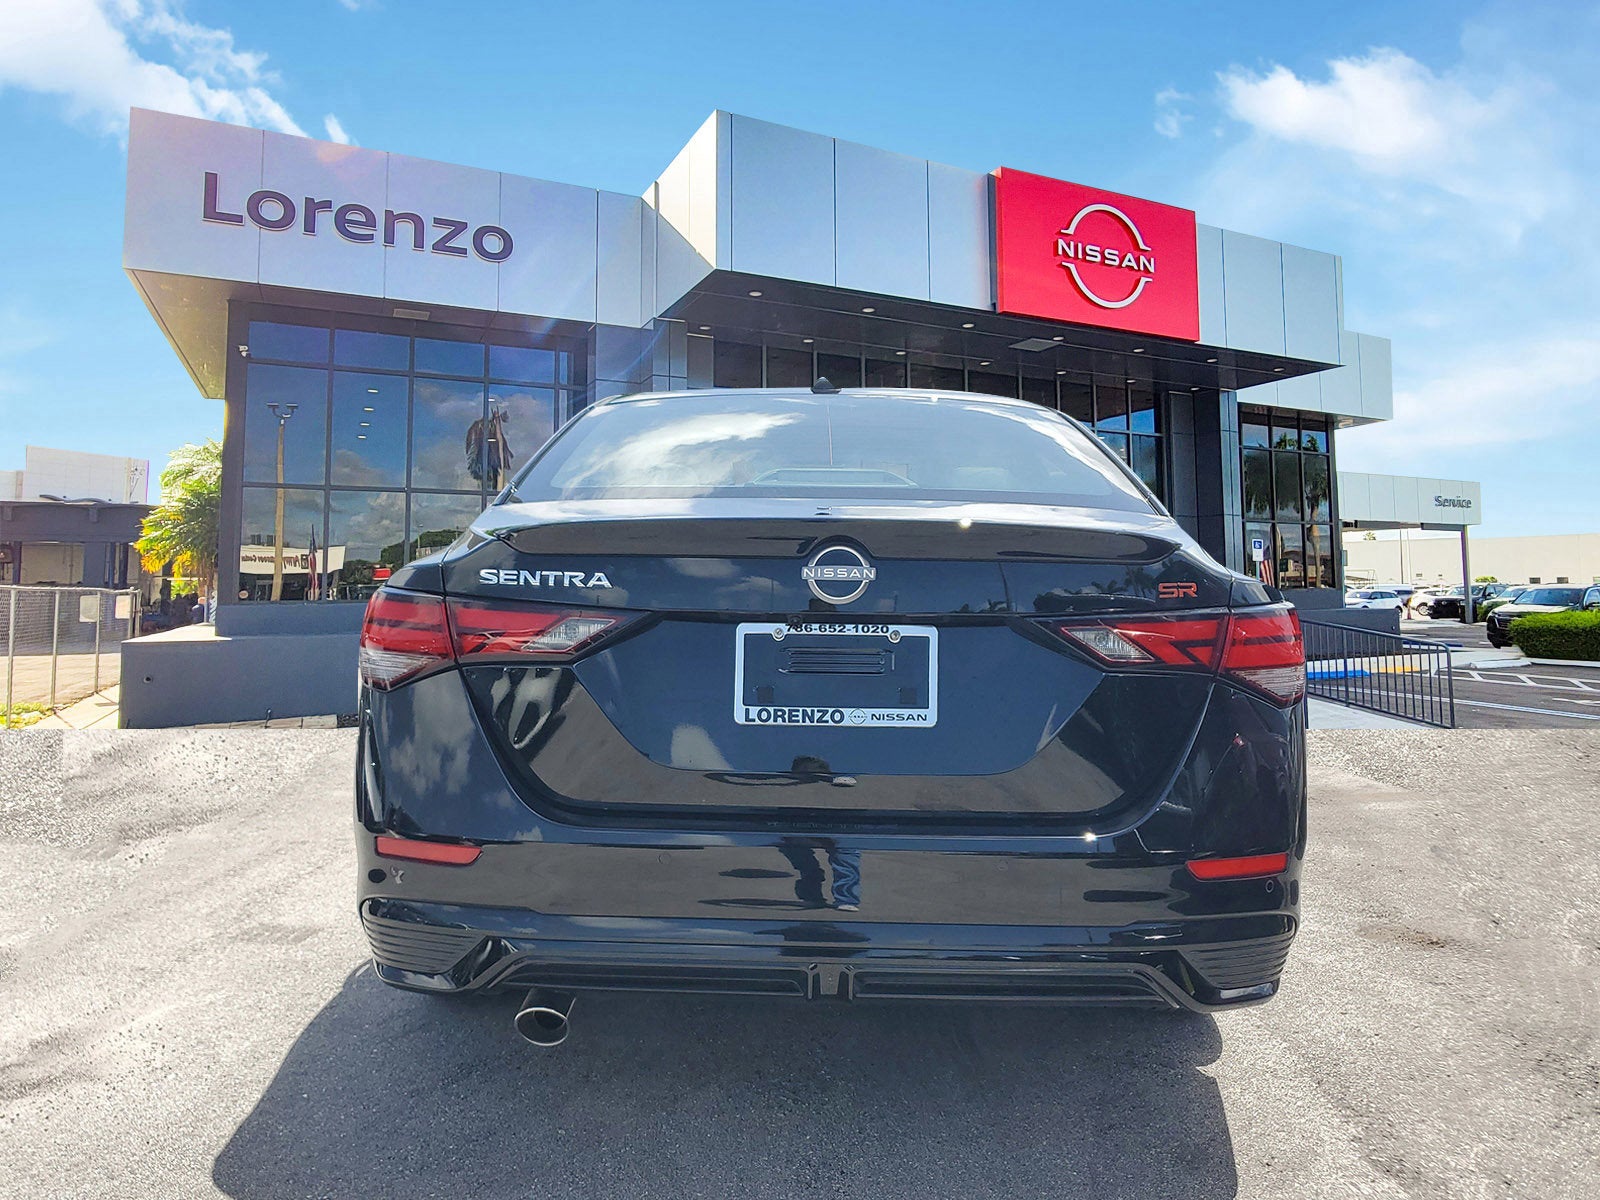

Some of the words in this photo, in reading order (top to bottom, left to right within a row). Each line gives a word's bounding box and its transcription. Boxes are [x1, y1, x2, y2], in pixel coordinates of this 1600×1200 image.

[202, 171, 515, 263] Lorenzo
[1057, 238, 1155, 273] NISSAN
[1434, 495, 1472, 508] Service
[479, 569, 613, 588] SENTRA
[803, 568, 875, 579] NISSAN
[1158, 582, 1198, 598] SR
[785, 623, 890, 634] 786-652-1020
[744, 707, 845, 724] LORENZO
[871, 713, 928, 721] NISSAN
